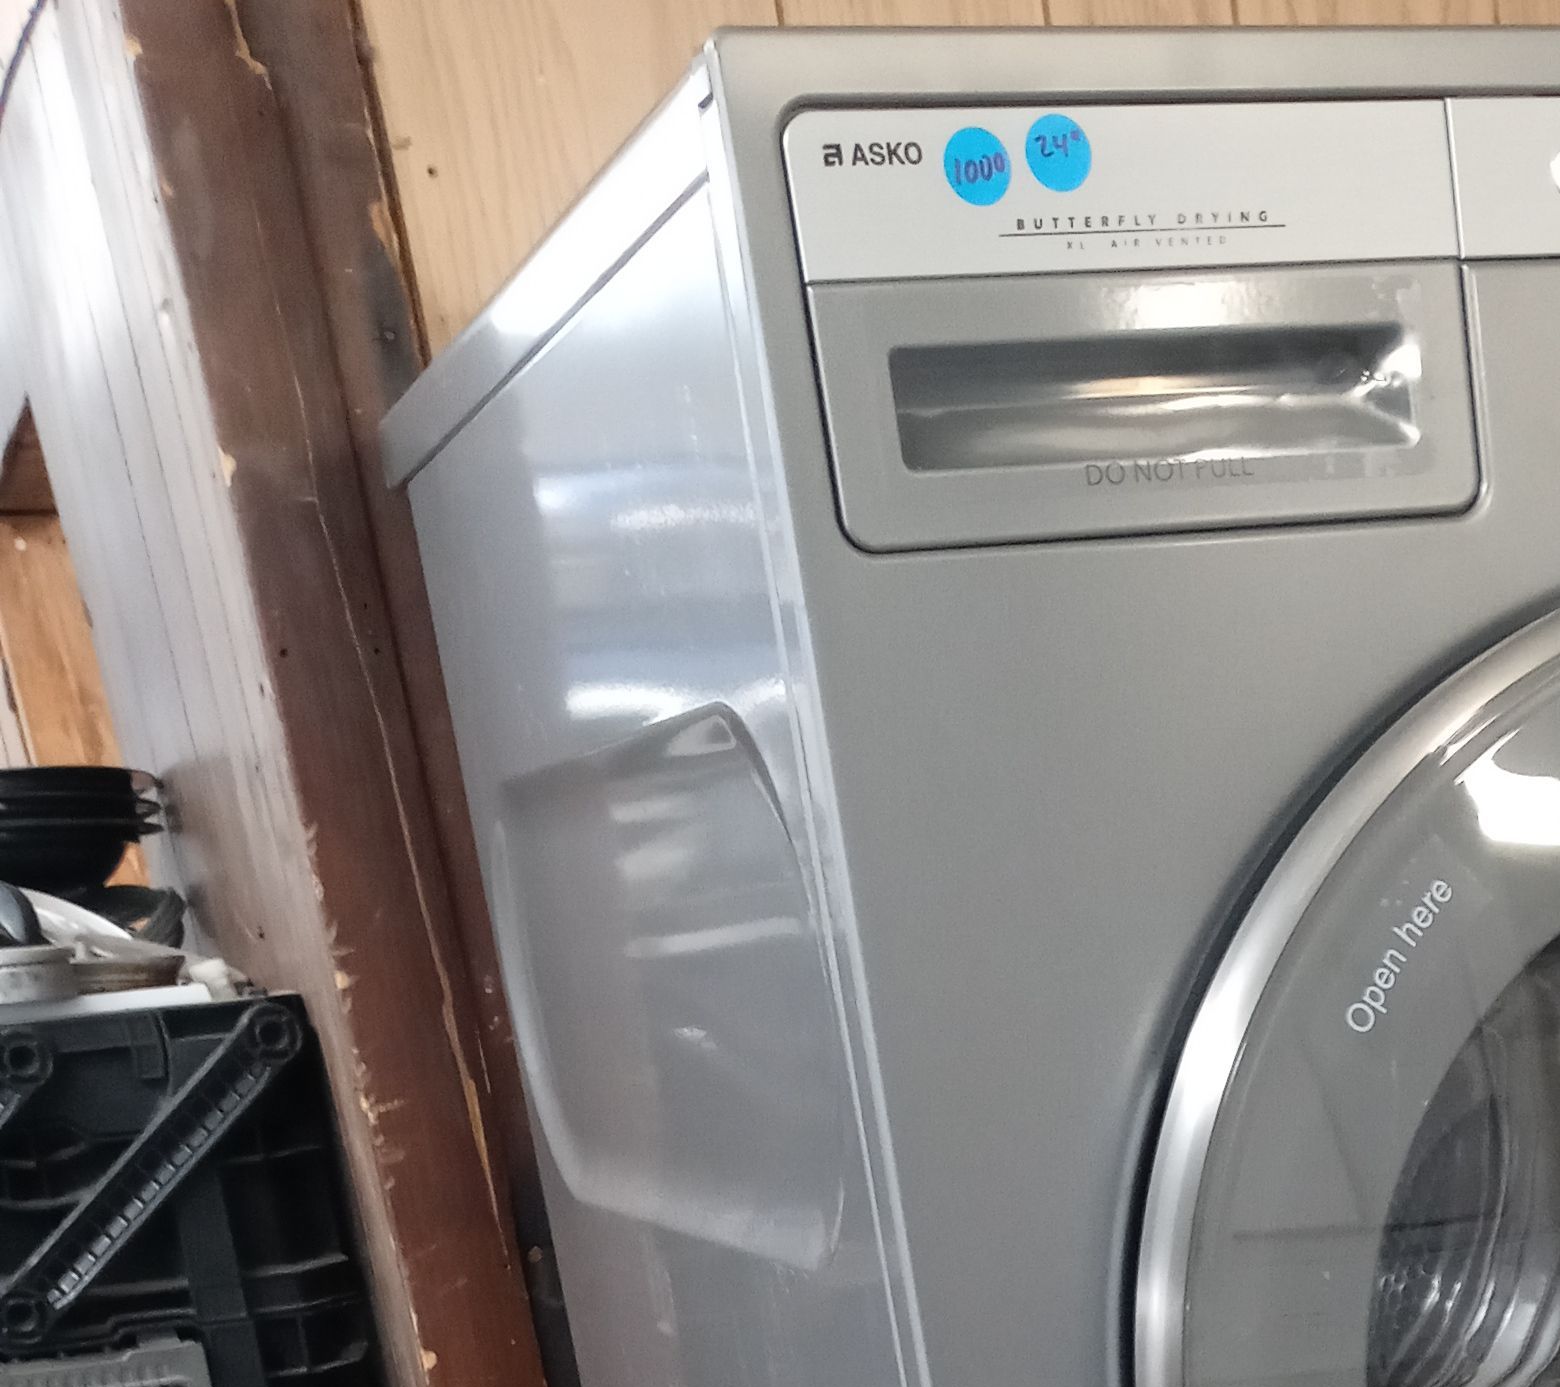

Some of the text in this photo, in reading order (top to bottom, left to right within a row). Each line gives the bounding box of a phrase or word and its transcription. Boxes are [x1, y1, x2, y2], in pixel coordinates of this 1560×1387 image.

[851, 142, 923, 167] ASKO
[953, 152, 1006, 186] 1000
[1016, 210, 1268, 231] BUTTERFLY DRYING
[1155, 235, 1227, 247] VENTED
[1085, 456, 1256, 486] DO NOT PULL
[1346, 879, 1453, 1033] Open here
